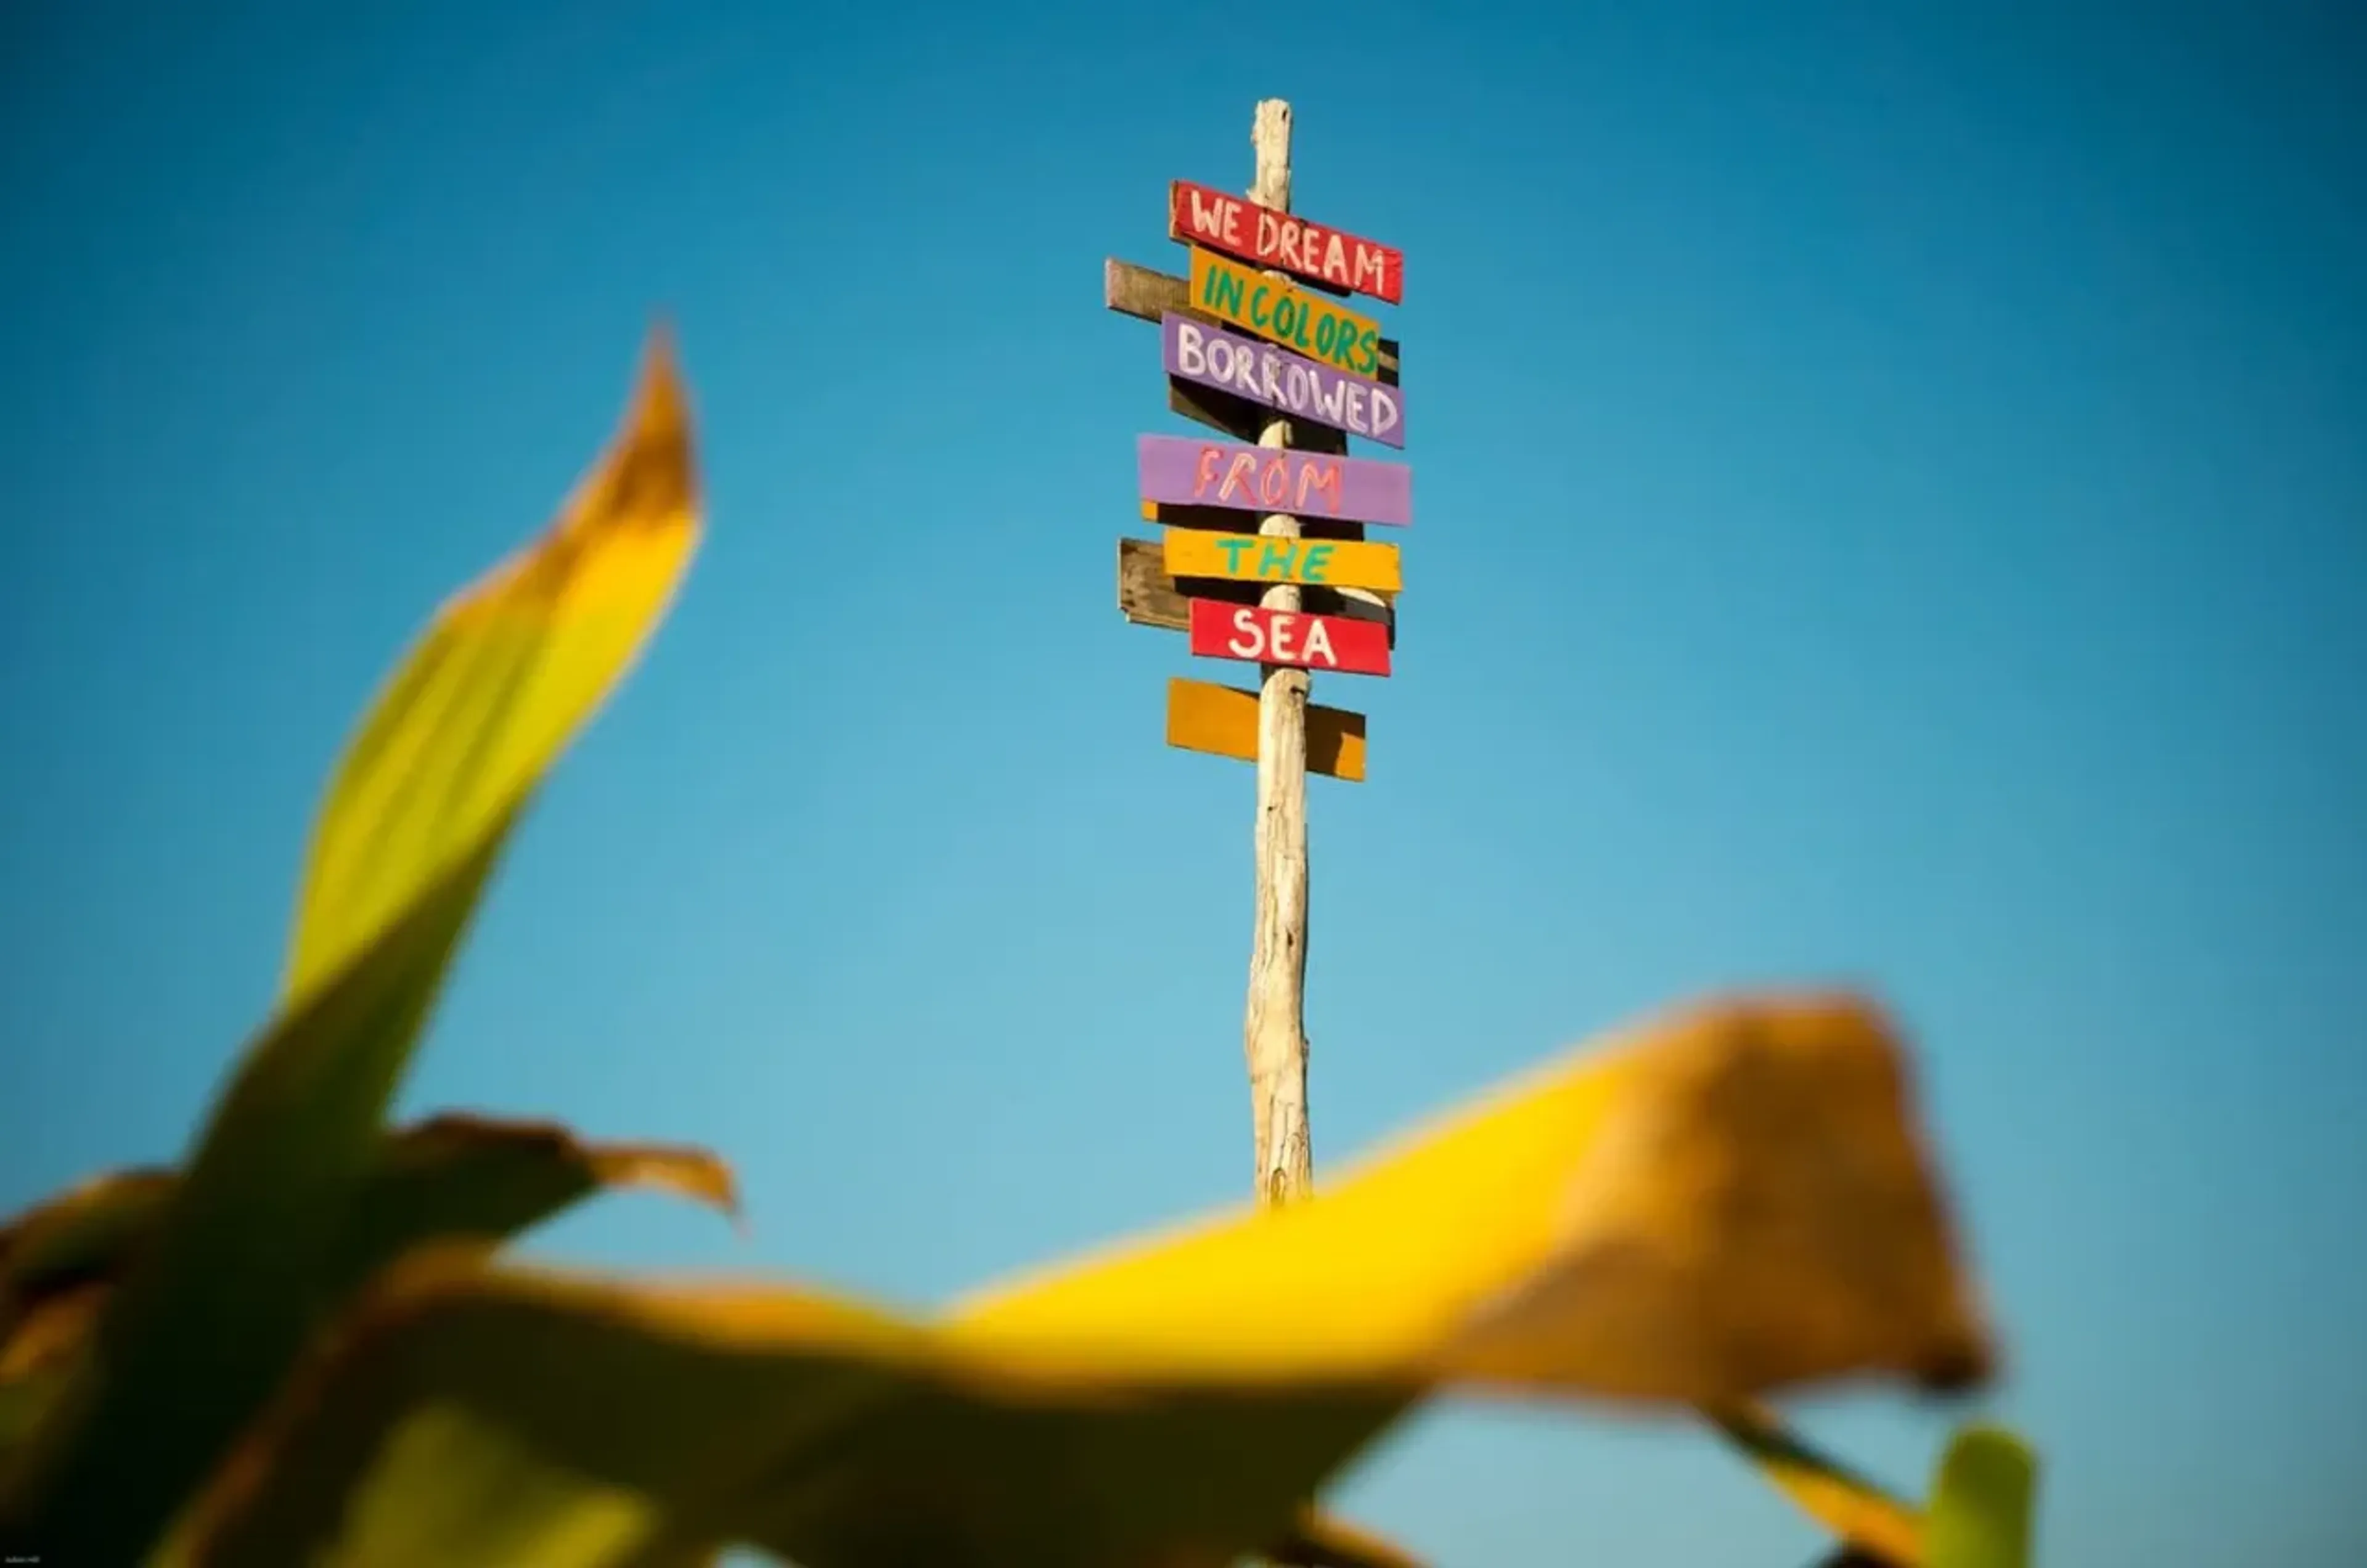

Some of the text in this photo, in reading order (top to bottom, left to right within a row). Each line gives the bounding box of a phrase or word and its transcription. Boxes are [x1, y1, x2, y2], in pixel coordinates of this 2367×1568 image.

[1191, 190, 1384, 295] WE DREAM
[1203, 265, 1377, 374] IN COLORS
[1178, 323, 1398, 436] BORROWED
[1195, 446, 1343, 514] FROM
[1216, 539, 1336, 581] THE
[1228, 610, 1338, 666] SEA
